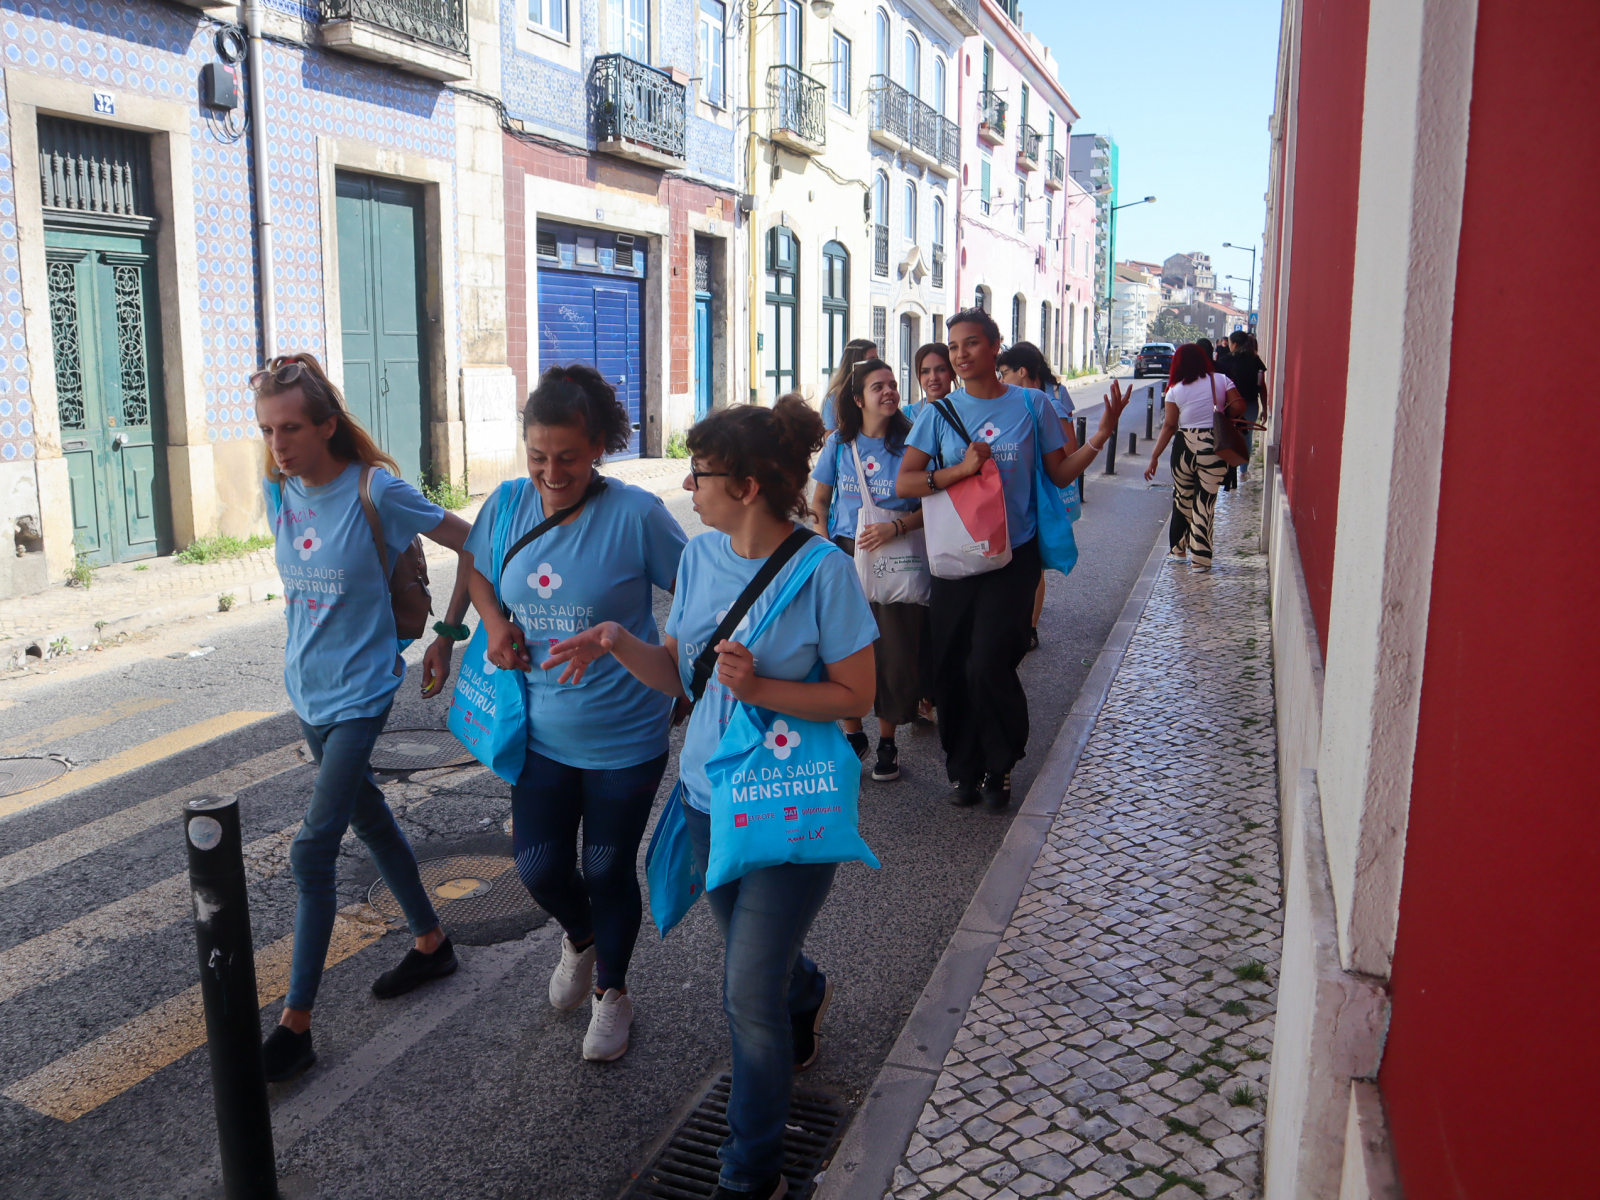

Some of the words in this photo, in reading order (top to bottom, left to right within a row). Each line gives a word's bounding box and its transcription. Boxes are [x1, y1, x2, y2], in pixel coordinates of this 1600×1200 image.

[96, 93, 112, 113] 32
[990, 442, 1019, 453] SAÚDE
[842, 474, 855, 483] DIA
[869, 477, 894, 488] SAÚDE
[290, 565, 304, 577] DA
[306, 566, 345, 580] SAÚDE
[283, 577, 345, 595] ENSTRUAL
[528, 604, 547, 615] DA
[550, 603, 594, 617] SAÚDE
[461, 664, 473, 680] DIA
[456, 676, 496, 719] MENSTRUA
[732, 769, 757, 785] DIA
[761, 767, 782, 781] DA
[786, 760, 836, 778] SAÚDE
[732, 776, 838, 803] MENSTRUAL
[748, 812, 775, 822] EUROPE
[808, 826, 825, 840] LX
